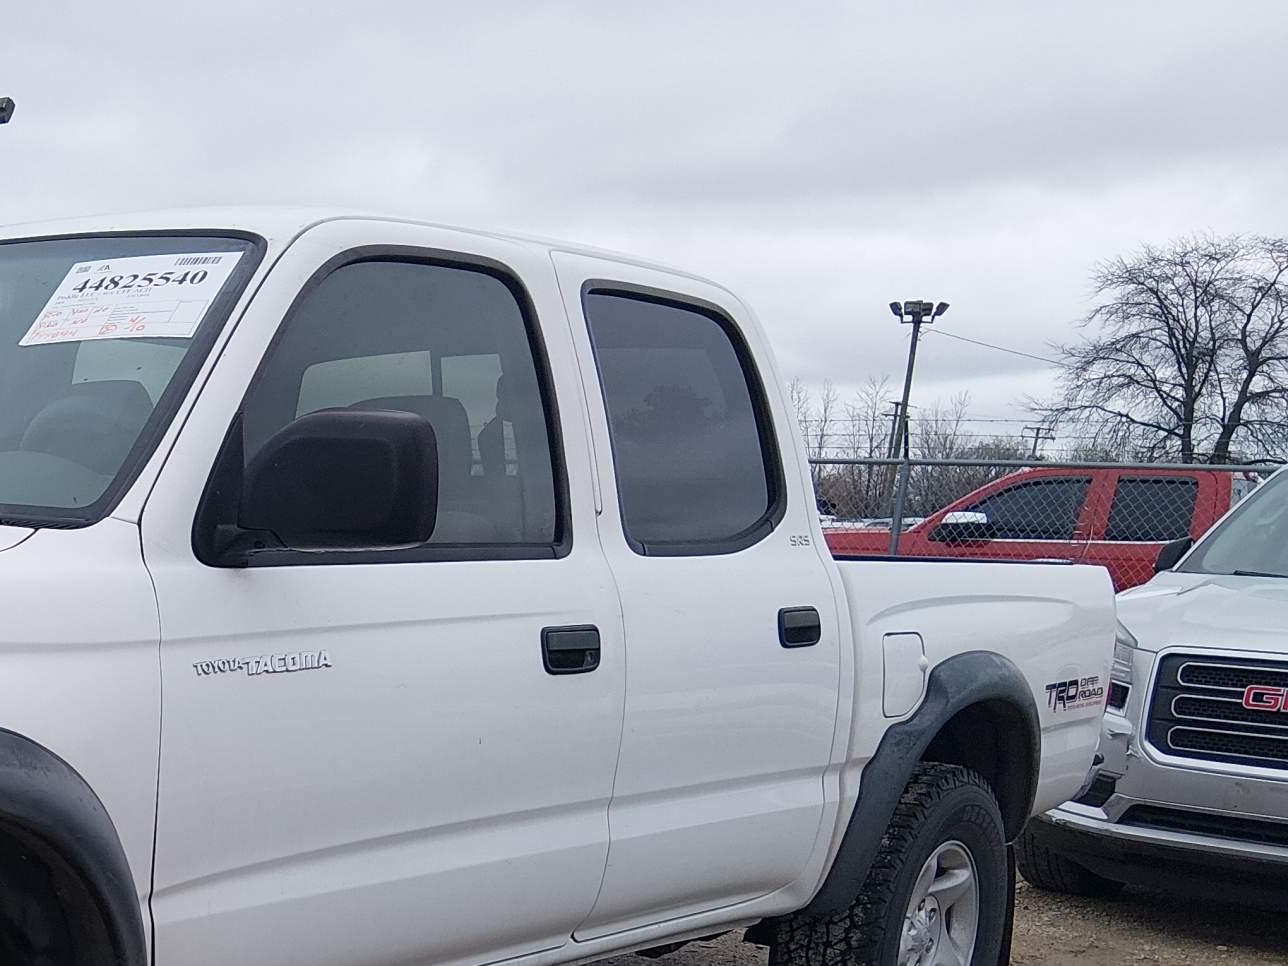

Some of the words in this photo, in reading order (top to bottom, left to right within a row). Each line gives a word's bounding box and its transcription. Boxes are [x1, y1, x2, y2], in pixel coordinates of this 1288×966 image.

[72, 270, 209, 294] 44825540
[193, 657, 244, 677] TOYOTA
[243, 650, 333, 677] TACOMA
[1045, 679, 1079, 713] TRD
[1080, 675, 1100, 688] OFF
[1078, 686, 1104, 700] ROAD
[1242, 684, 1288, 713] G
